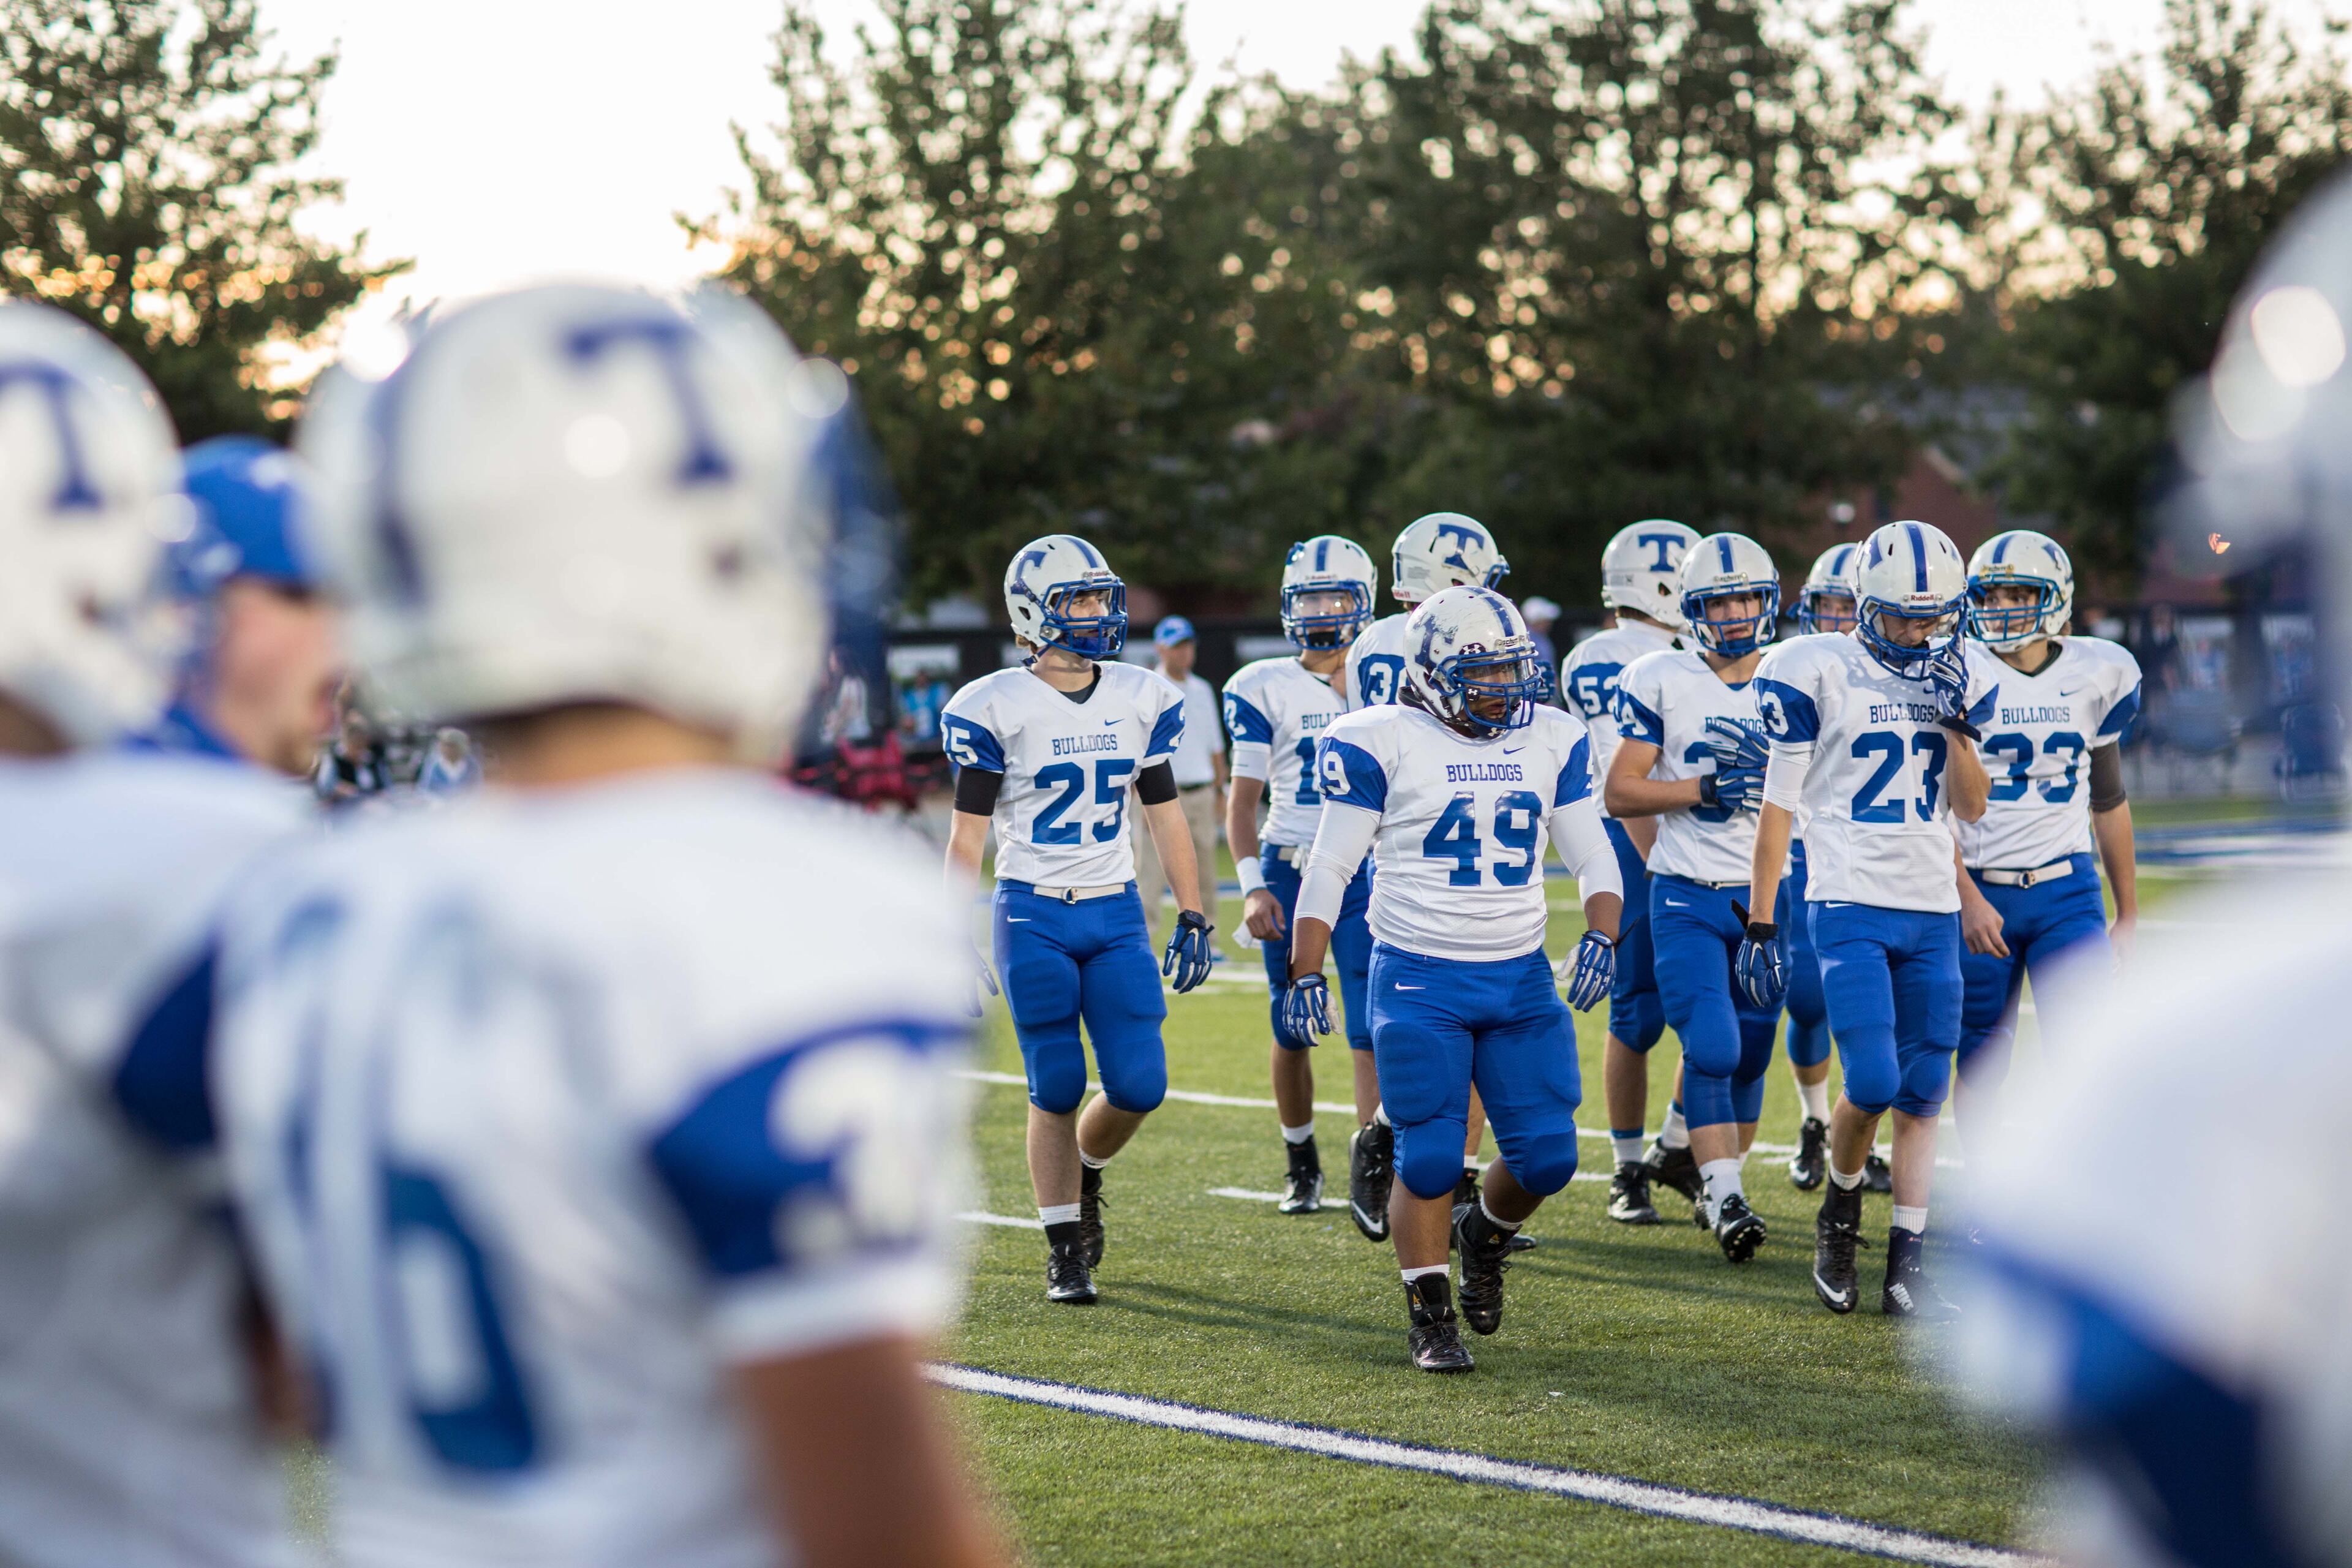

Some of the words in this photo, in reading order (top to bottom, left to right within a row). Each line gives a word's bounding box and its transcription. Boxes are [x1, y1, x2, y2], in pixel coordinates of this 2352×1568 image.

[1438, 523, 1485, 570] T
[1638, 533, 1686, 573] T
[1869, 703, 1936, 724] BULLDOGS
[2001, 706, 2071, 725] BULLDOGS
[1052, 734, 1118, 756] BULLDOGS
[1317, 750, 1351, 796] 9
[1446, 763, 1523, 783] BULLDOGS
[1850, 730, 1948, 824] 23
[1983, 731, 2086, 804] 33
[1031, 758, 1135, 845] 25
[1422, 790, 1543, 887] 49
[1888, 1282, 1915, 1313] NIKE
